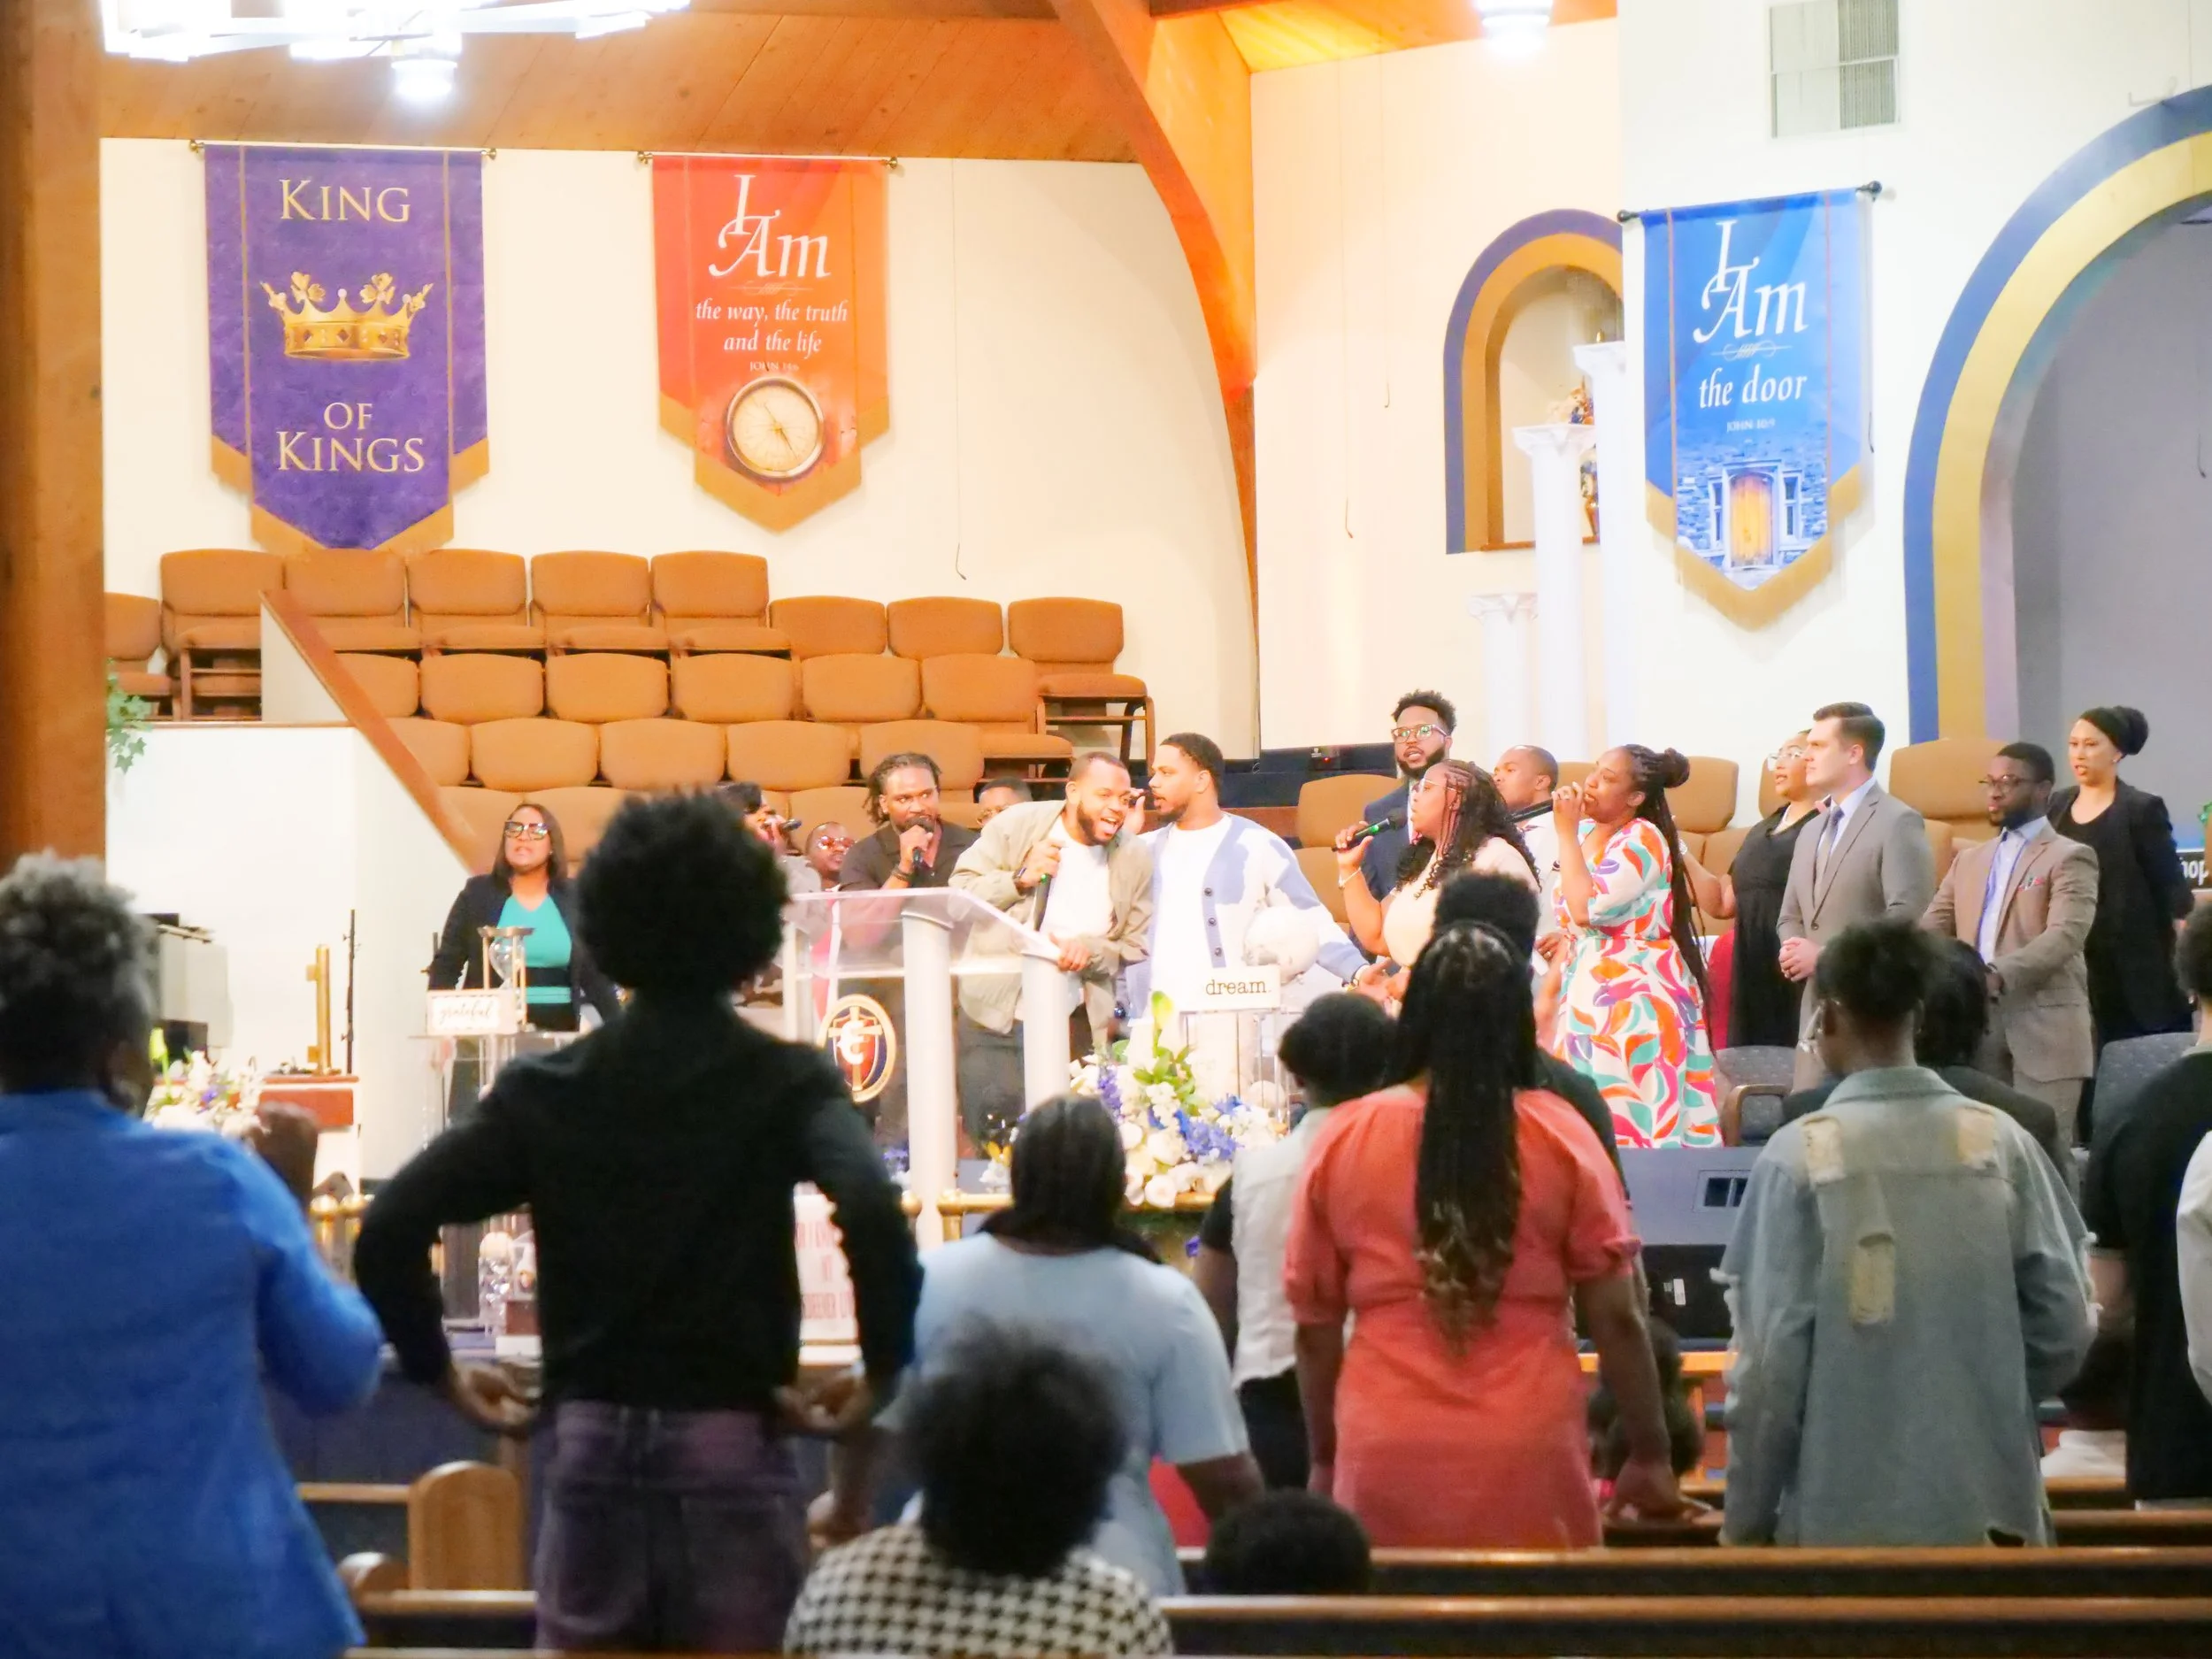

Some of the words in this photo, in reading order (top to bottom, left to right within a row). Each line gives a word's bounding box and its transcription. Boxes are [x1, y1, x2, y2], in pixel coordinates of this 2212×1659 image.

[279, 179, 411, 223] KING
[727, 174, 757, 235] I
[708, 209, 832, 279] Am
[1709, 219, 1738, 294] I
[695, 297, 722, 320] the
[726, 305, 769, 327] way,
[774, 299, 800, 321] the
[805, 299, 849, 322] truth
[1692, 257, 1809, 344] Am
[723, 328, 760, 352] and
[765, 329, 792, 352] the
[796, 330, 823, 360] life
[1699, 366, 1734, 409] the
[1741, 363, 1809, 404] door
[323, 402, 374, 430] OF
[1726, 419, 1754, 433] JOHN
[276, 430, 426, 473] KINGS
